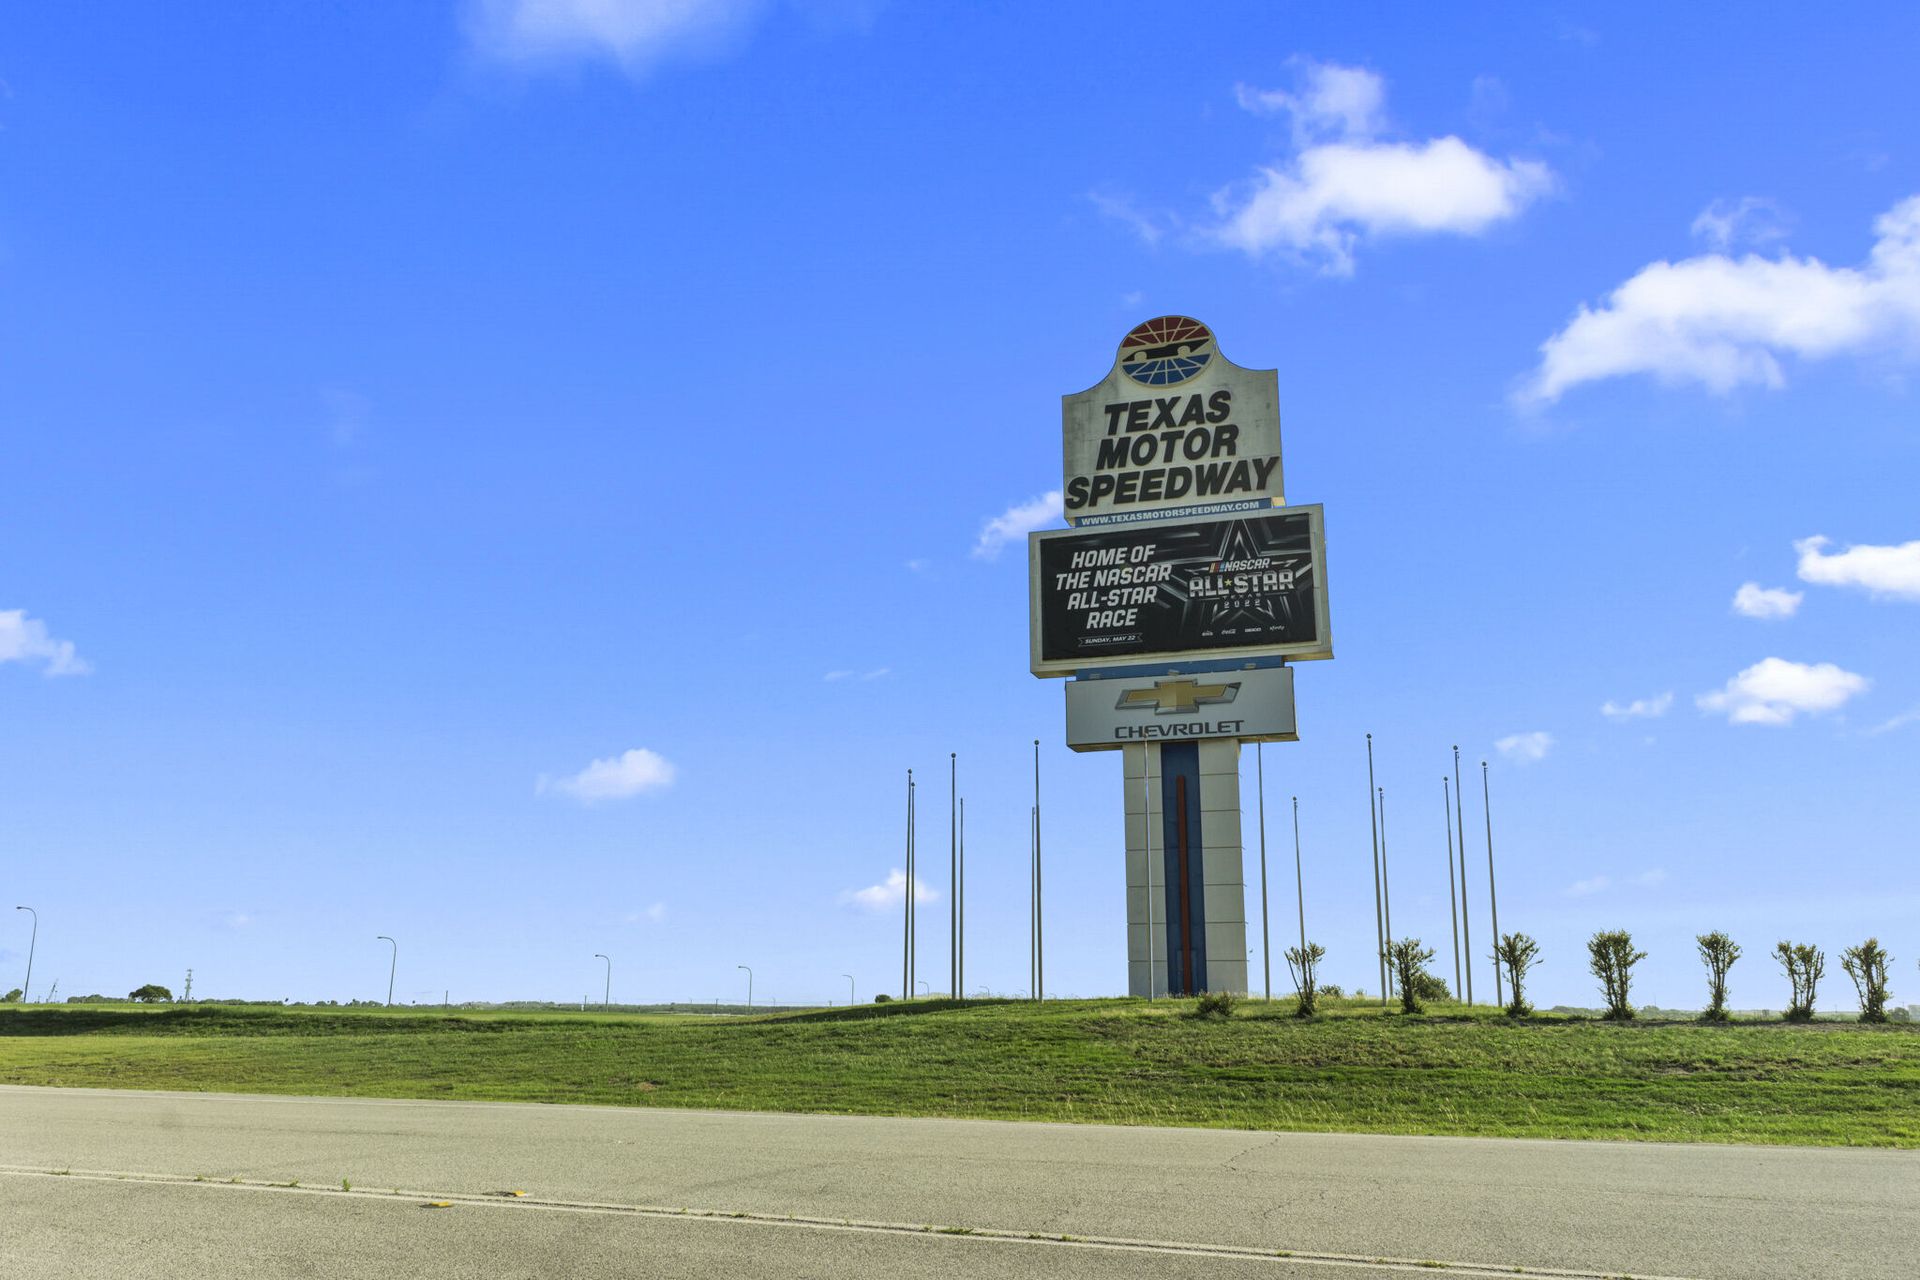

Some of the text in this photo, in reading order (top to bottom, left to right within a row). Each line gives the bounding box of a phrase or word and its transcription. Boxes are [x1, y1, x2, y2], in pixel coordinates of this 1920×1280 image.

[1104, 390, 1231, 435] TEXAS
[1096, 424, 1239, 470] MOTOR
[1065, 456, 1280, 510] SPEEDWAY
[1081, 501, 1260, 526] WWW.TEXASMOTORSPEEDWAY.COM
[1071, 544, 1156, 569] HOME OF
[1224, 558, 1270, 572] NASCAR
[1056, 563, 1172, 591] THE NASCAR
[1189, 569, 1295, 598] ALL STAR
[1067, 585, 1158, 610] ALL-STAR
[1086, 608, 1138, 629] RACE
[1114, 720, 1244, 739] CHEVROLET
